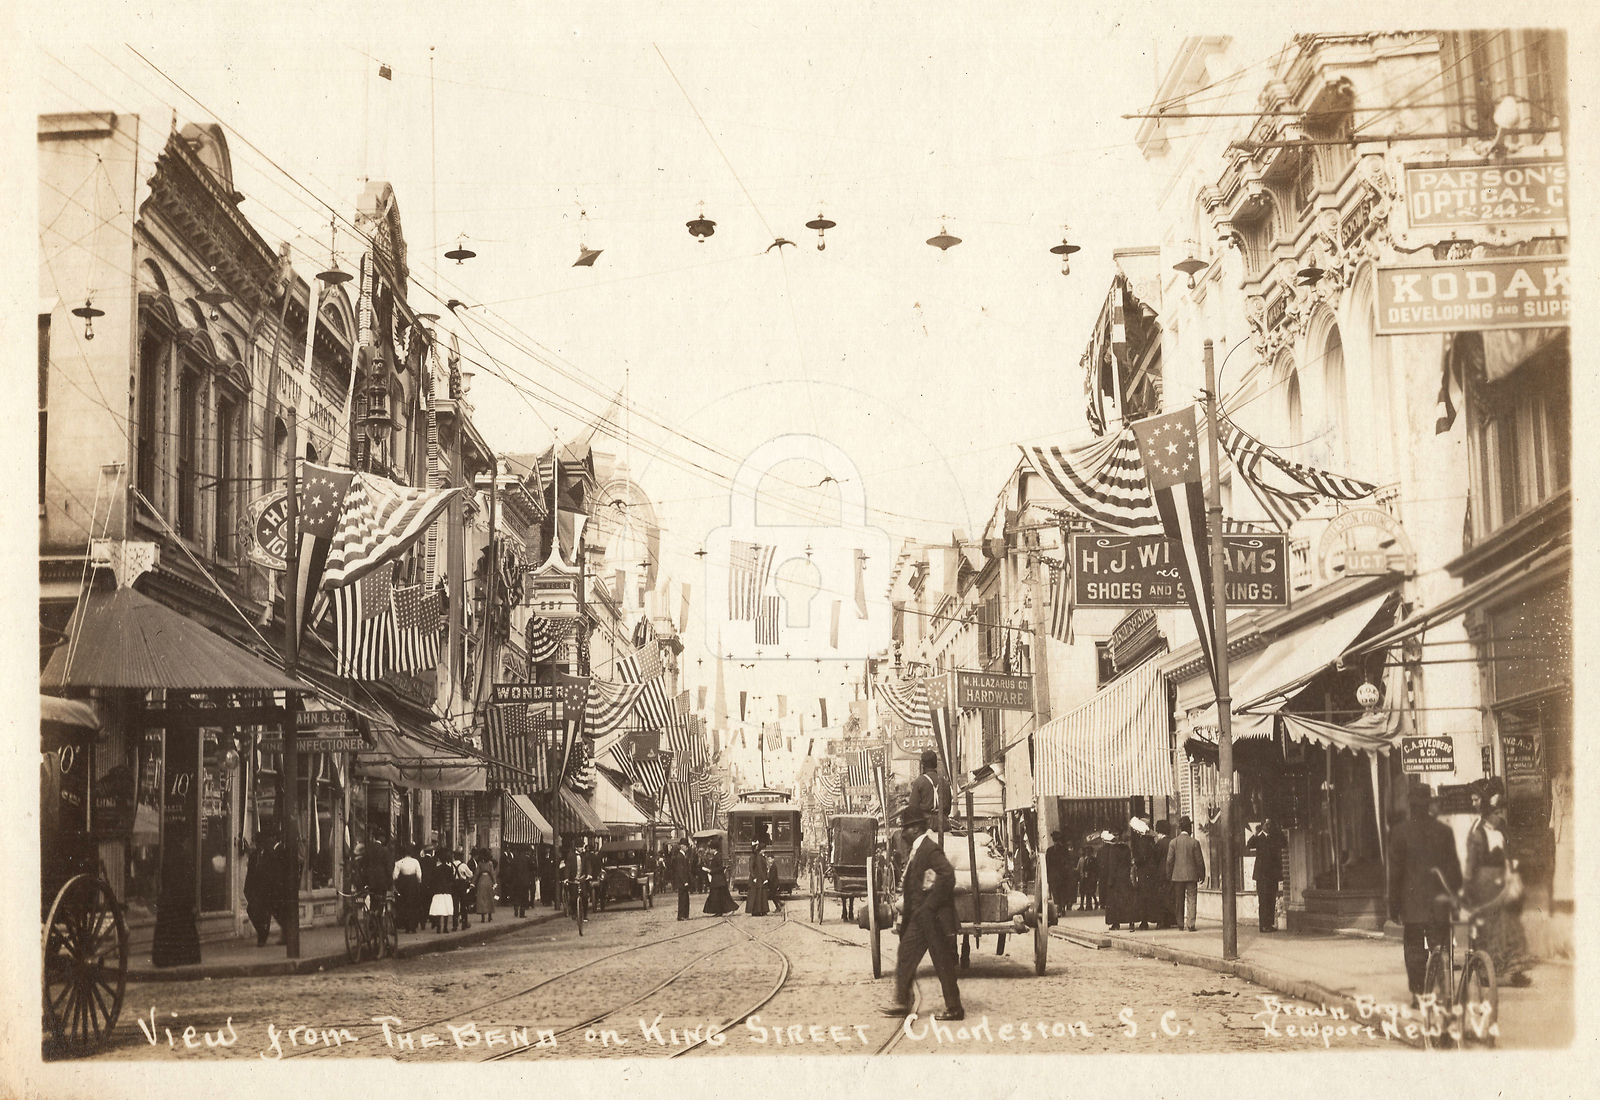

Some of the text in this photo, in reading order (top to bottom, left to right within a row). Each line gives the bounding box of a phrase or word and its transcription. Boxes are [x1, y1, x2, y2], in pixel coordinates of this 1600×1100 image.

[1412, 187, 1536, 220] OPTICAL
[1480, 204, 1518, 219] 244
[1390, 266, 1571, 303] KODAK
[1388, 303, 1494, 324] DEVELOPING
[1496, 305, 1519, 316] AND
[1087, 583, 1278, 600] SHOES AND SKINGS.
[966, 688, 1028, 706] HARDWARE.
[296, 713, 318, 724] AHN
[321, 712, 330, 724] &
[296, 739, 374, 751] NFECTIONER.
[903, 739, 938, 749] CIGA
[1419, 748, 1438, 757] & CO.
